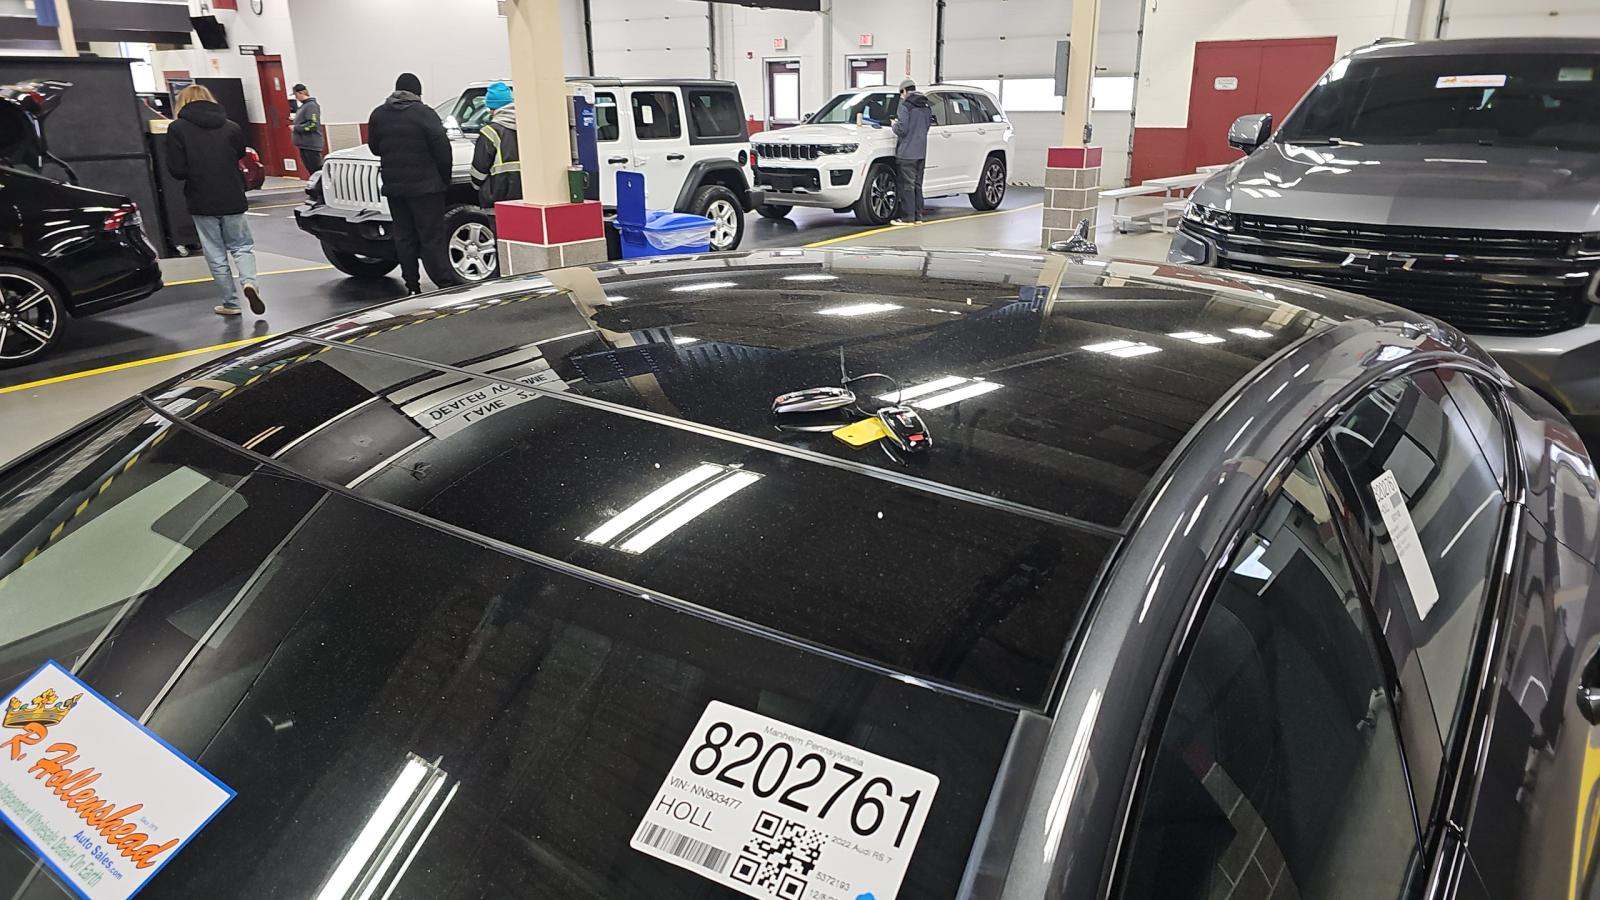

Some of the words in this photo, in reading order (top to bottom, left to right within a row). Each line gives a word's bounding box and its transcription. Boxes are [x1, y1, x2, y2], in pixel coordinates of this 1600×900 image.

[763, 725, 805, 746] Manheim
[803, 738, 864, 767] Pennsylvania
[0, 721, 48, 761] R.
[28, 743, 180, 869] Hollenshead
[689, 721, 921, 848] 8202761
[690, 783, 743, 810] NN903477
[655, 794, 713, 832] HOLL
[73, 830, 93, 850] Auto
[91, 845, 125, 880] Sales.com
[79, 862, 105, 888] Earth
